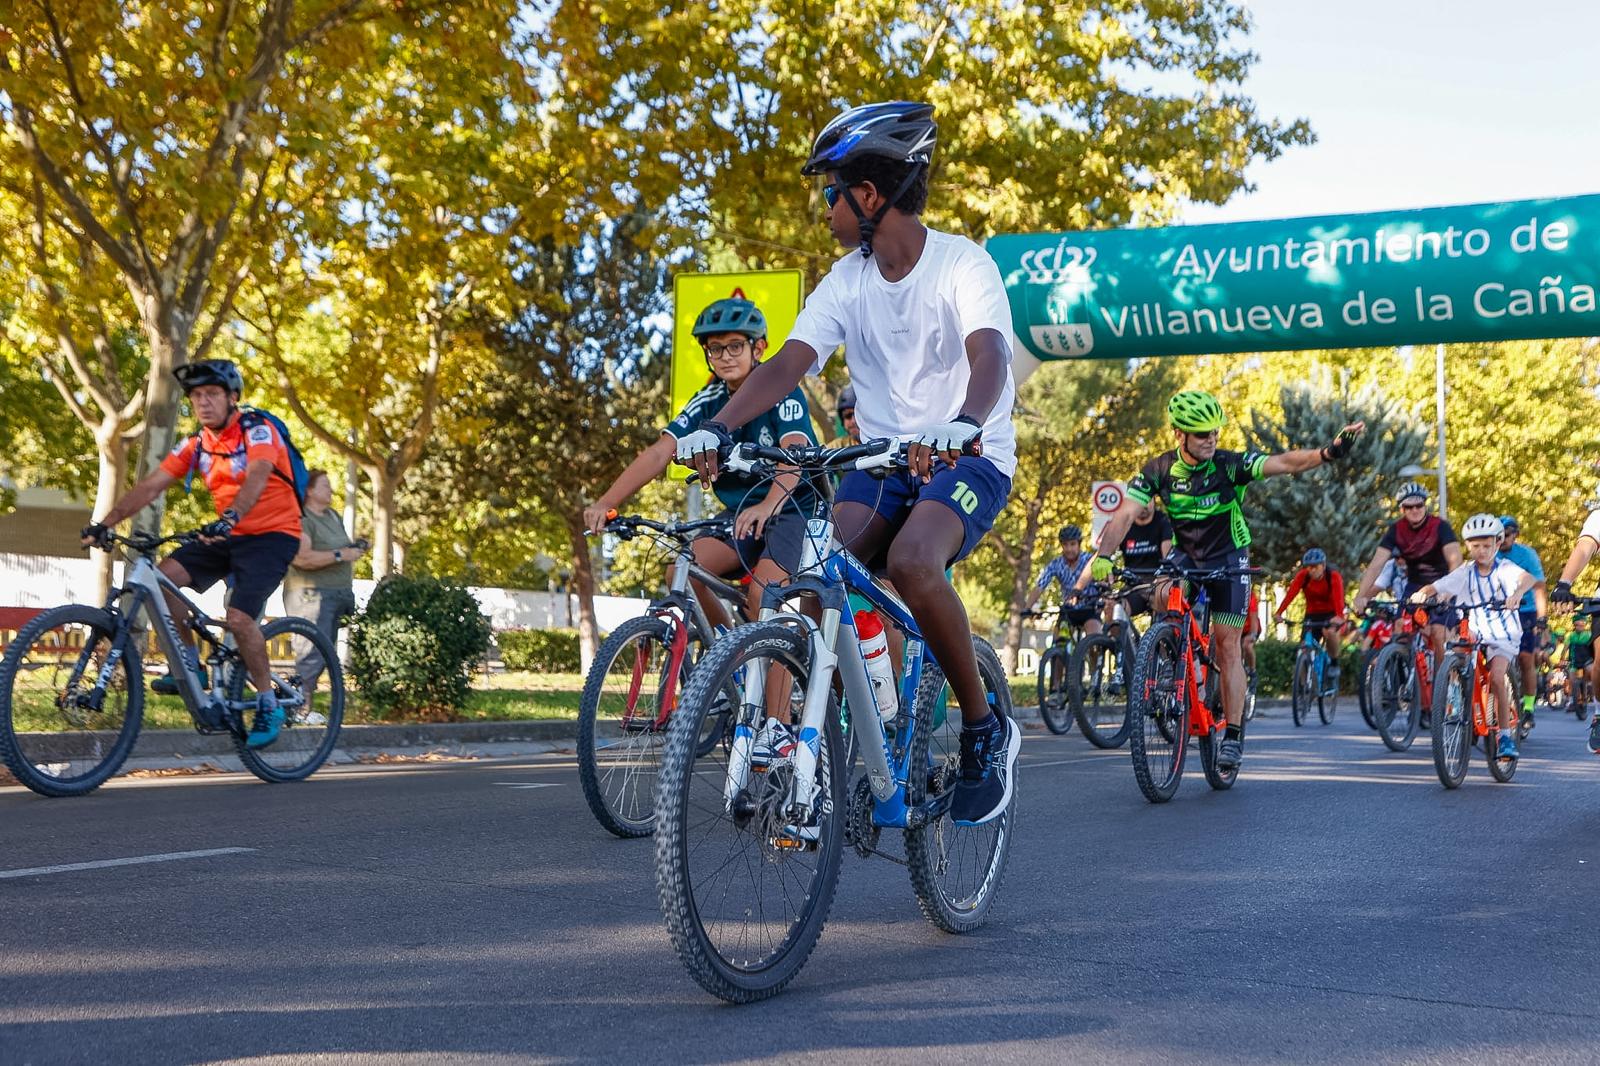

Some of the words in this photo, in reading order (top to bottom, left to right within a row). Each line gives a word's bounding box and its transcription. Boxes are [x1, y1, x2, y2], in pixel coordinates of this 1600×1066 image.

[1172, 225, 1491, 284] Ayuntamiento
[1509, 216, 1569, 254] de
[1100, 301, 1325, 337] Villanueva
[1342, 289, 1397, 326] de
[1414, 285, 1454, 322] la
[782, 400, 801, 420] hp
[950, 480, 978, 515] 10
[1100, 493, 1118, 504] 20
